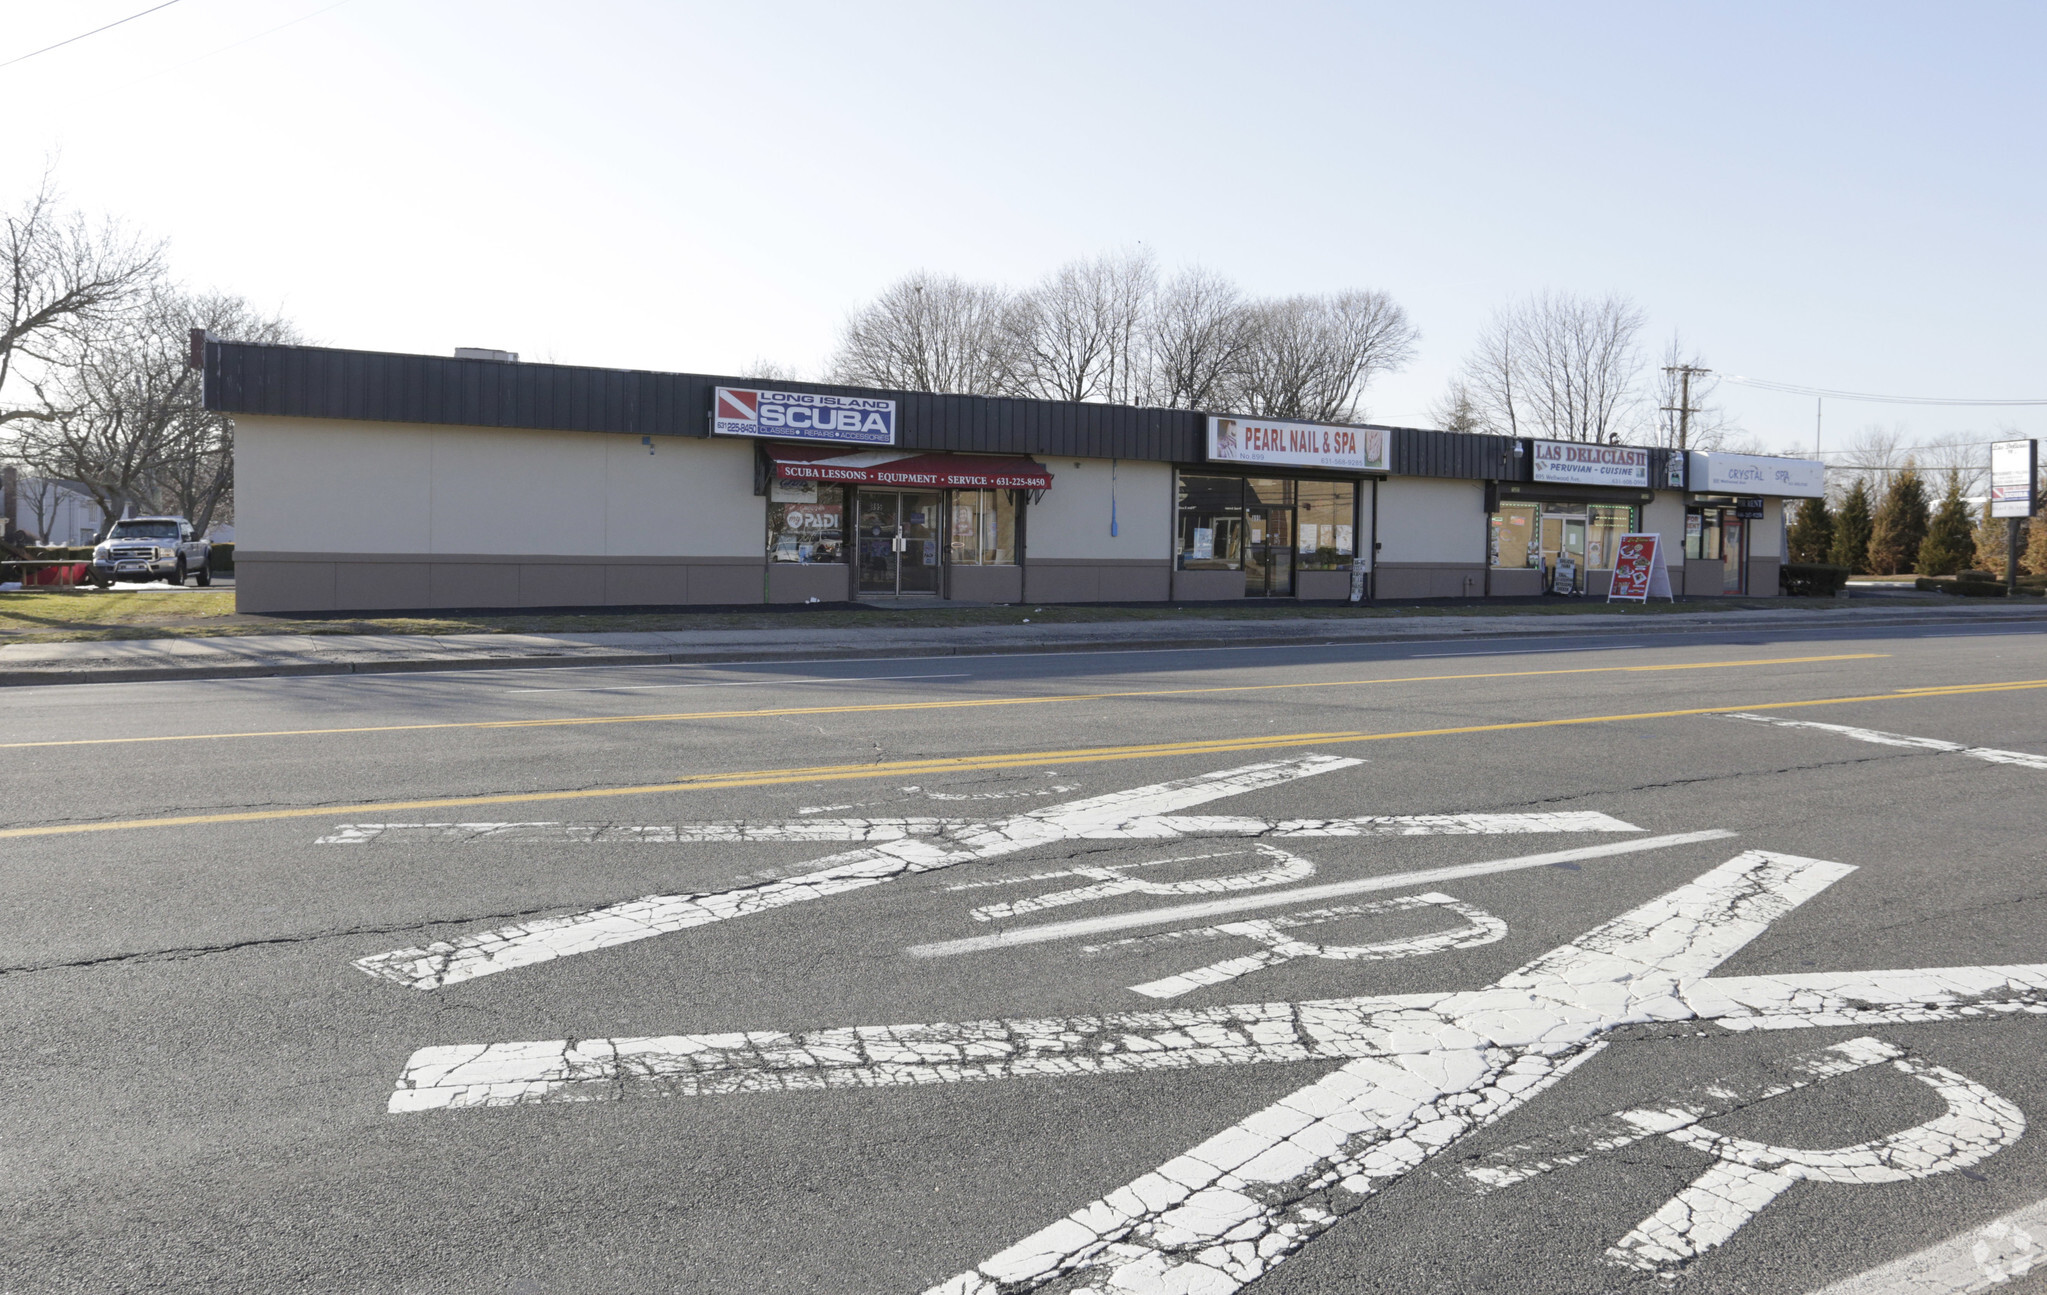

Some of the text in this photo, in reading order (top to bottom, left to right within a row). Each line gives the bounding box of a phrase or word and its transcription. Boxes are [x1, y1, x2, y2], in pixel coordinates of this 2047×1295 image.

[760, 392, 889, 409] LONG ISLAND
[760, 404, 888, 434] SCUBA
[760, 427, 890, 442] CLASSES REPAIRS ACCESSORIES
[1245, 427, 1357, 454] PEARL NAIL & SPA
[1536, 444, 1646, 466] LAS DELICIAS II
[784, 466, 1046, 487] SCUBA LESSONS EQUIPMENT SERVICE 631-225-8450
[1550, 463, 1592, 473] PERUVIAN
[1600, 467, 1633, 476] CUISINE
[1728, 468, 1790, 481] CRYSTAL SPA
[804, 513, 839, 528] PADI
